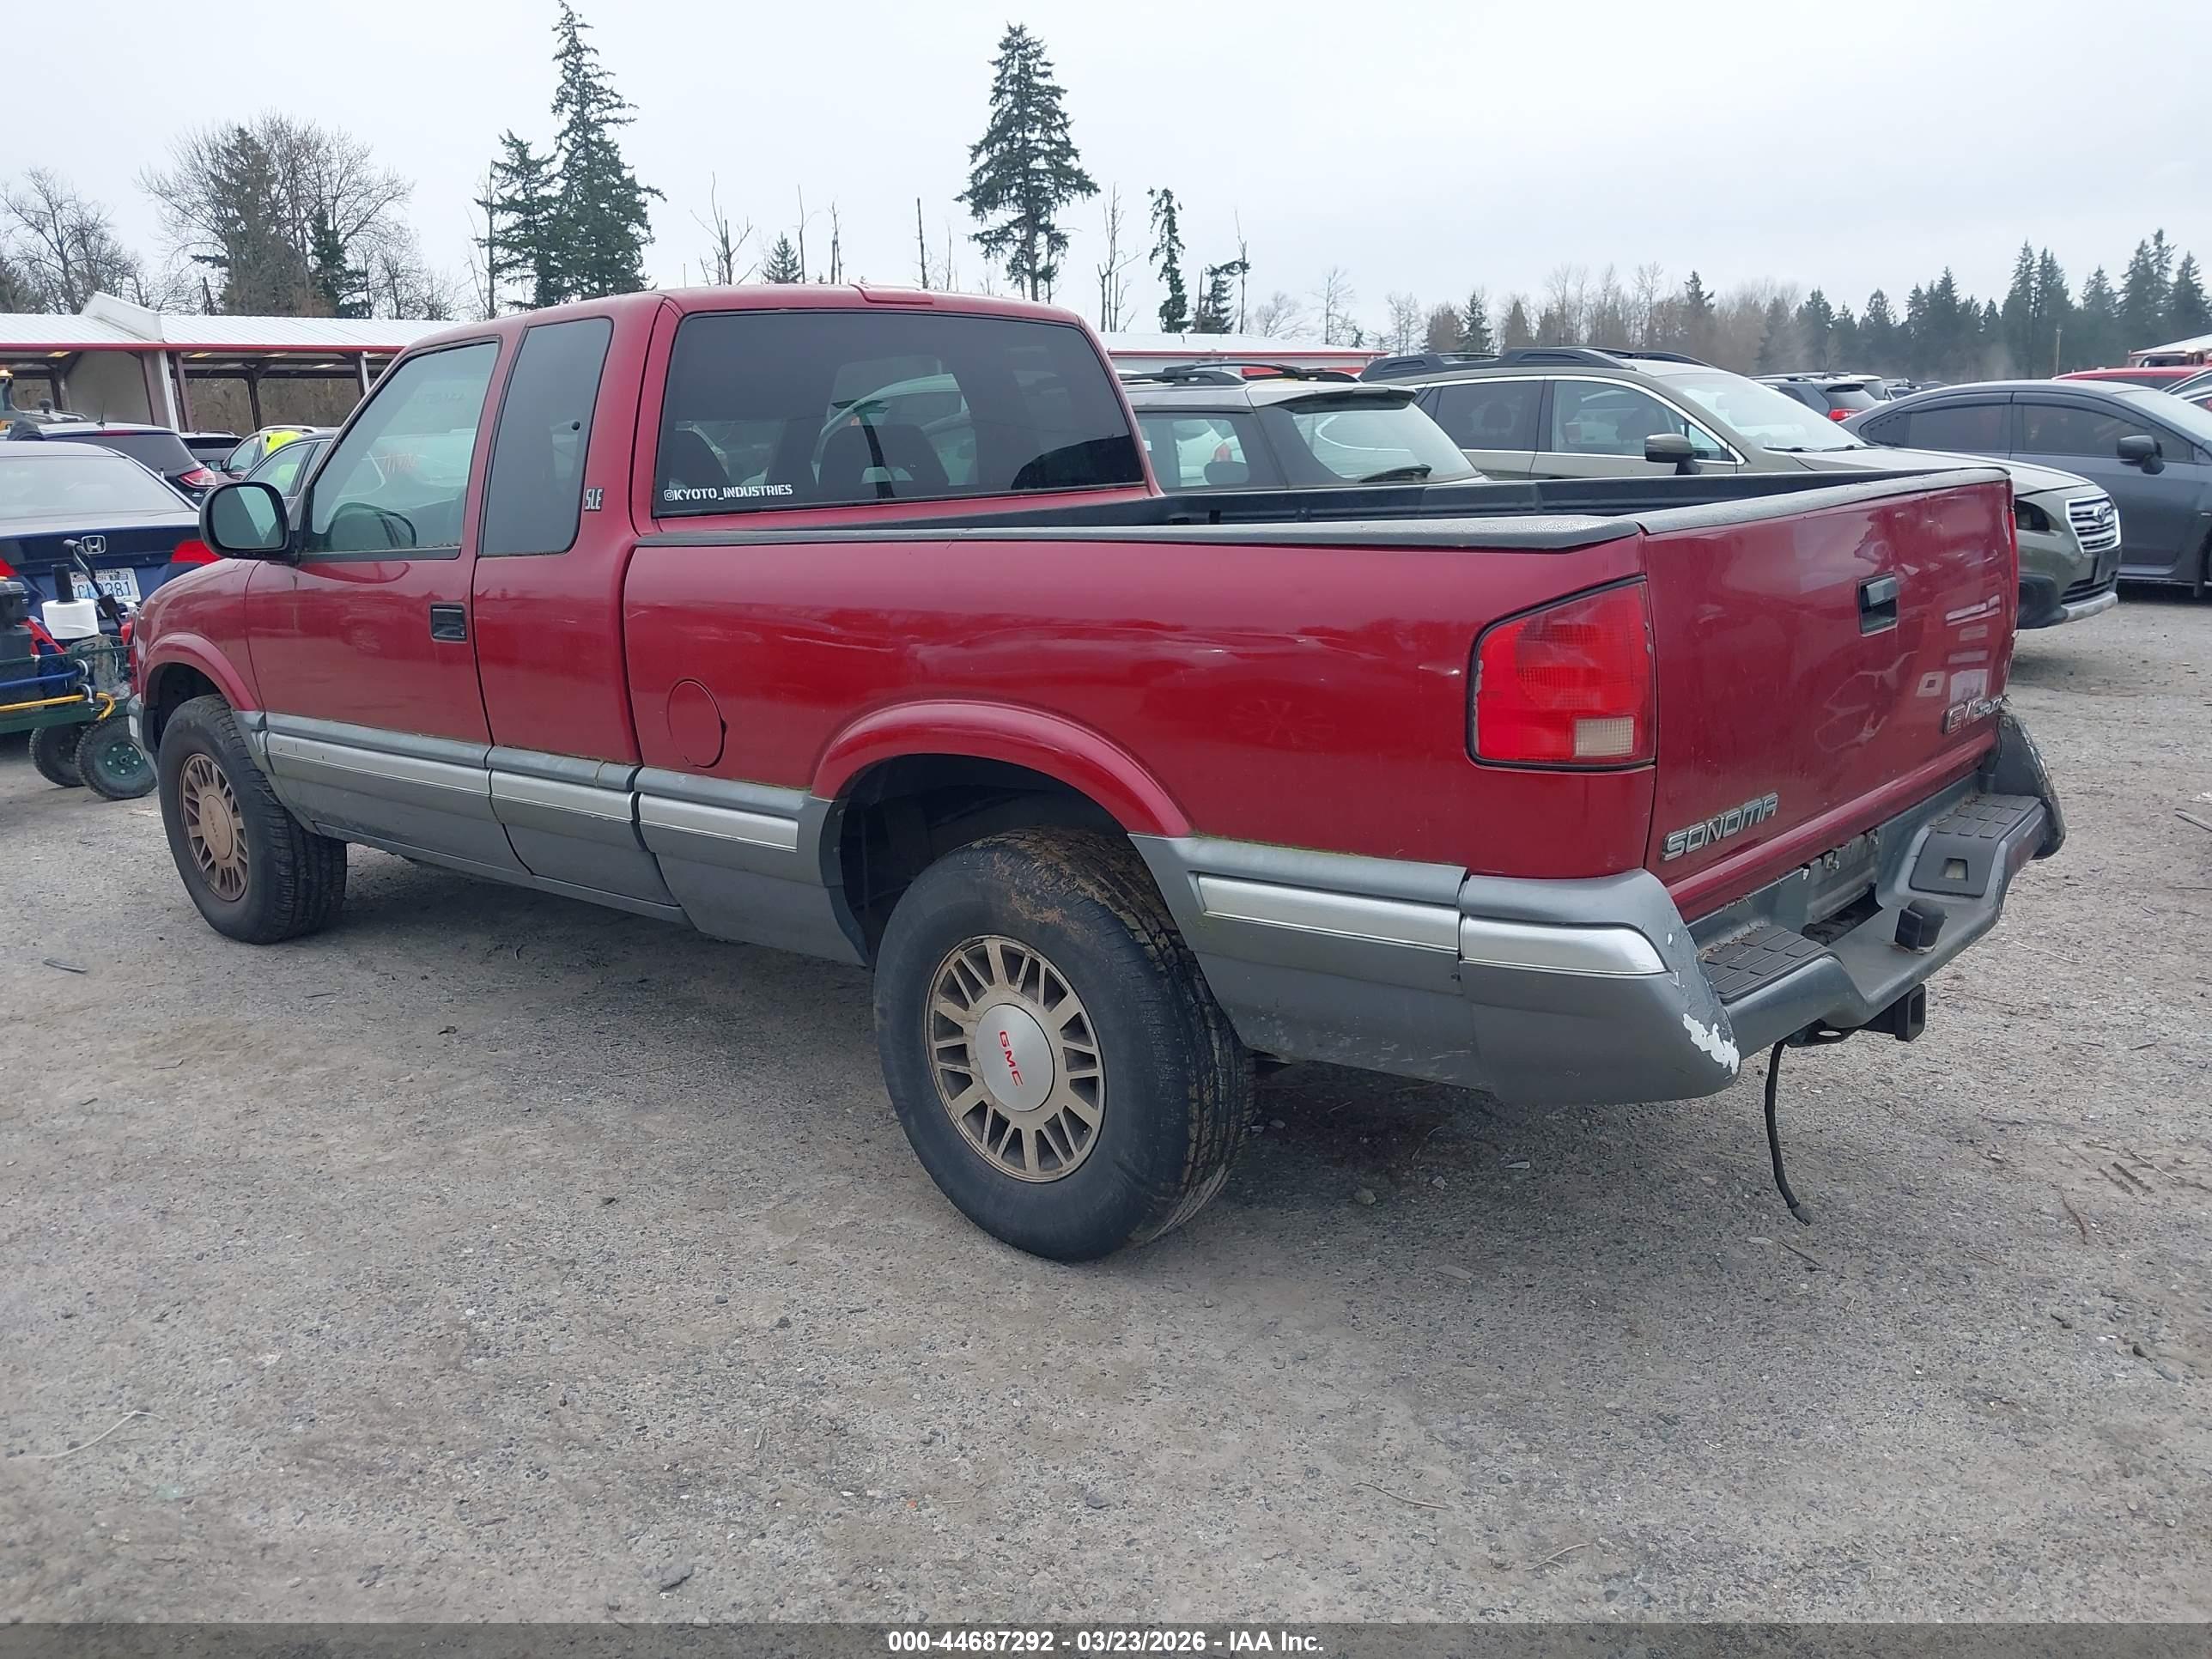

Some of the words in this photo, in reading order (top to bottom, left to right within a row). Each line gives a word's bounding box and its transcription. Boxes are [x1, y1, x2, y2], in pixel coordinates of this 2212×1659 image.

[585, 488, 603, 510] SLE
[1663, 792, 1779, 861] SONOMA
[1000, 1030, 1024, 1086] GMC
